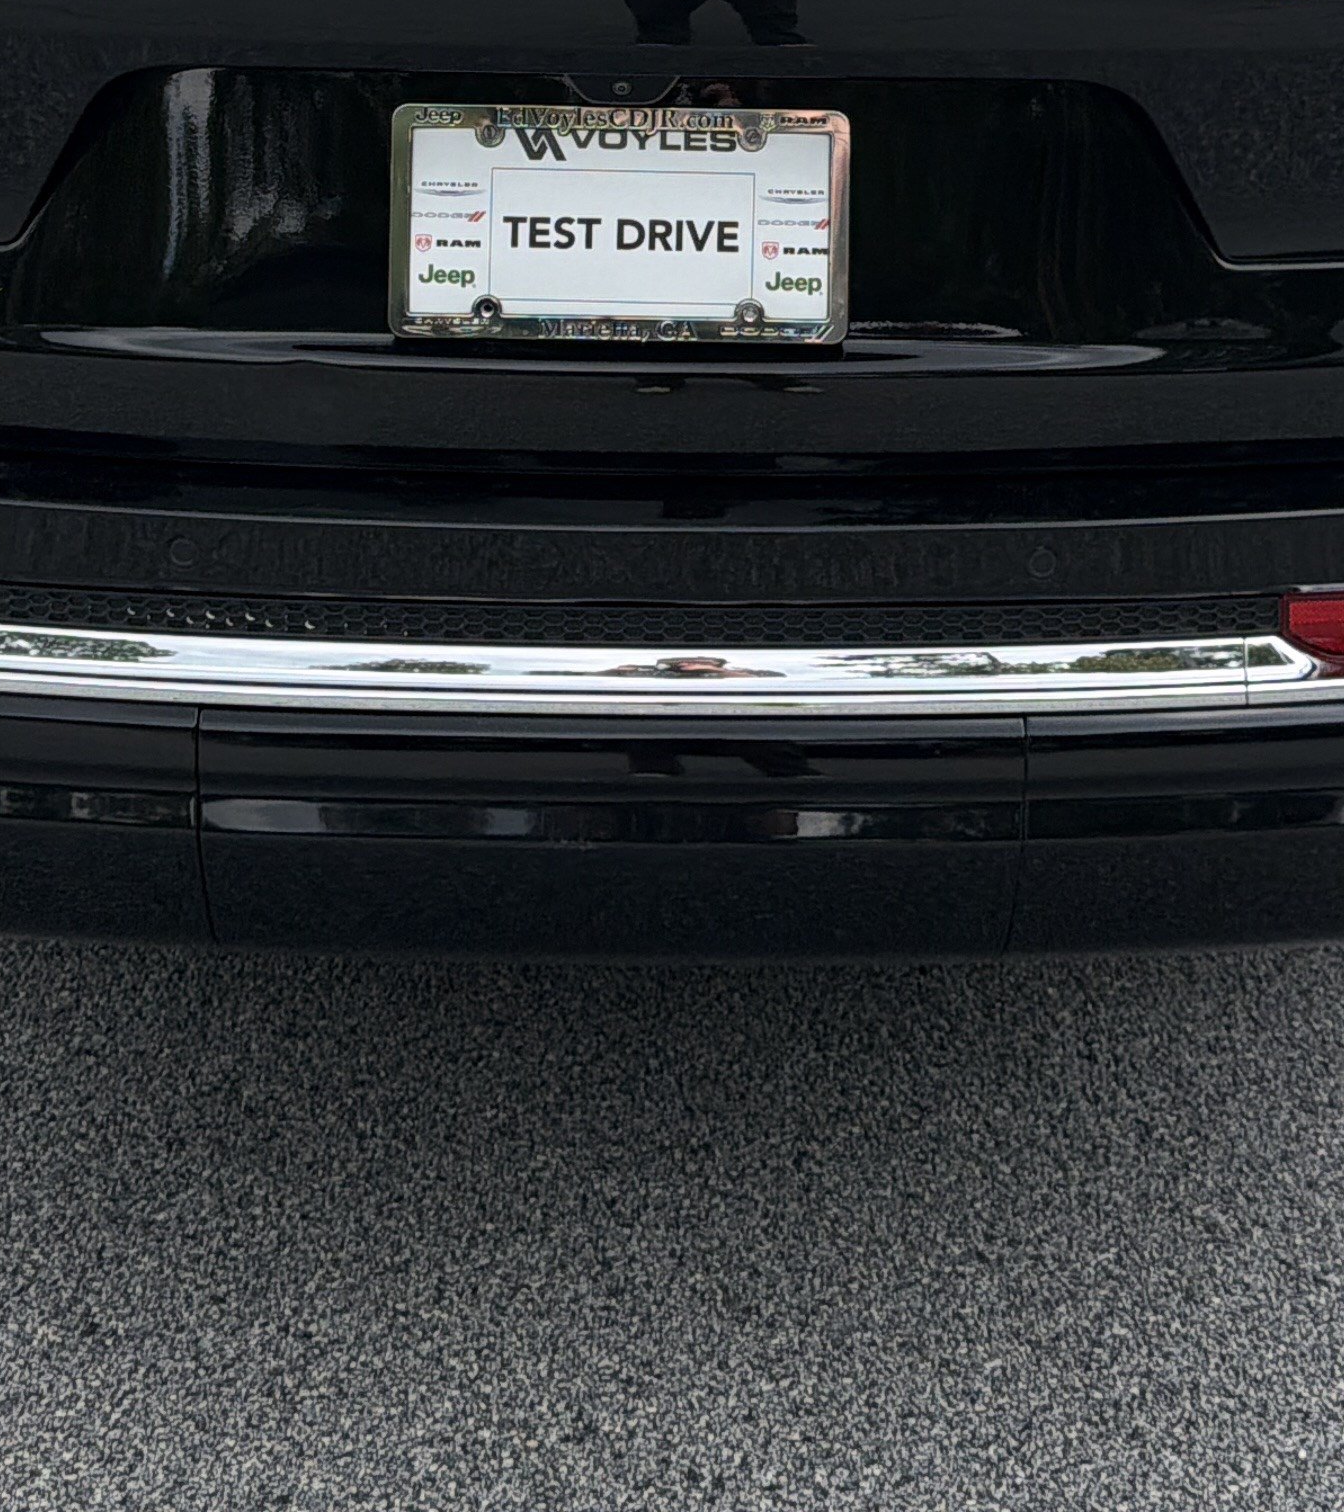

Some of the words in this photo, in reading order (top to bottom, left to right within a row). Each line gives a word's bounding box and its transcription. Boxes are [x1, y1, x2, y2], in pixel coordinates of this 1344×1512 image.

[415, 107, 462, 124] Jeep
[496, 106, 734, 136] EdVoylesCDJR.com
[780, 116, 828, 127] RAM
[570, 127, 737, 153] VOYLES
[435, 239, 482, 248] RAM
[502, 215, 602, 249] TEST
[616, 218, 740, 253] DRIVE
[783, 246, 829, 255] RAM
[418, 263, 476, 288] Jeep
[765, 271, 823, 296] Jeep
[657, 320, 699, 342] GA
